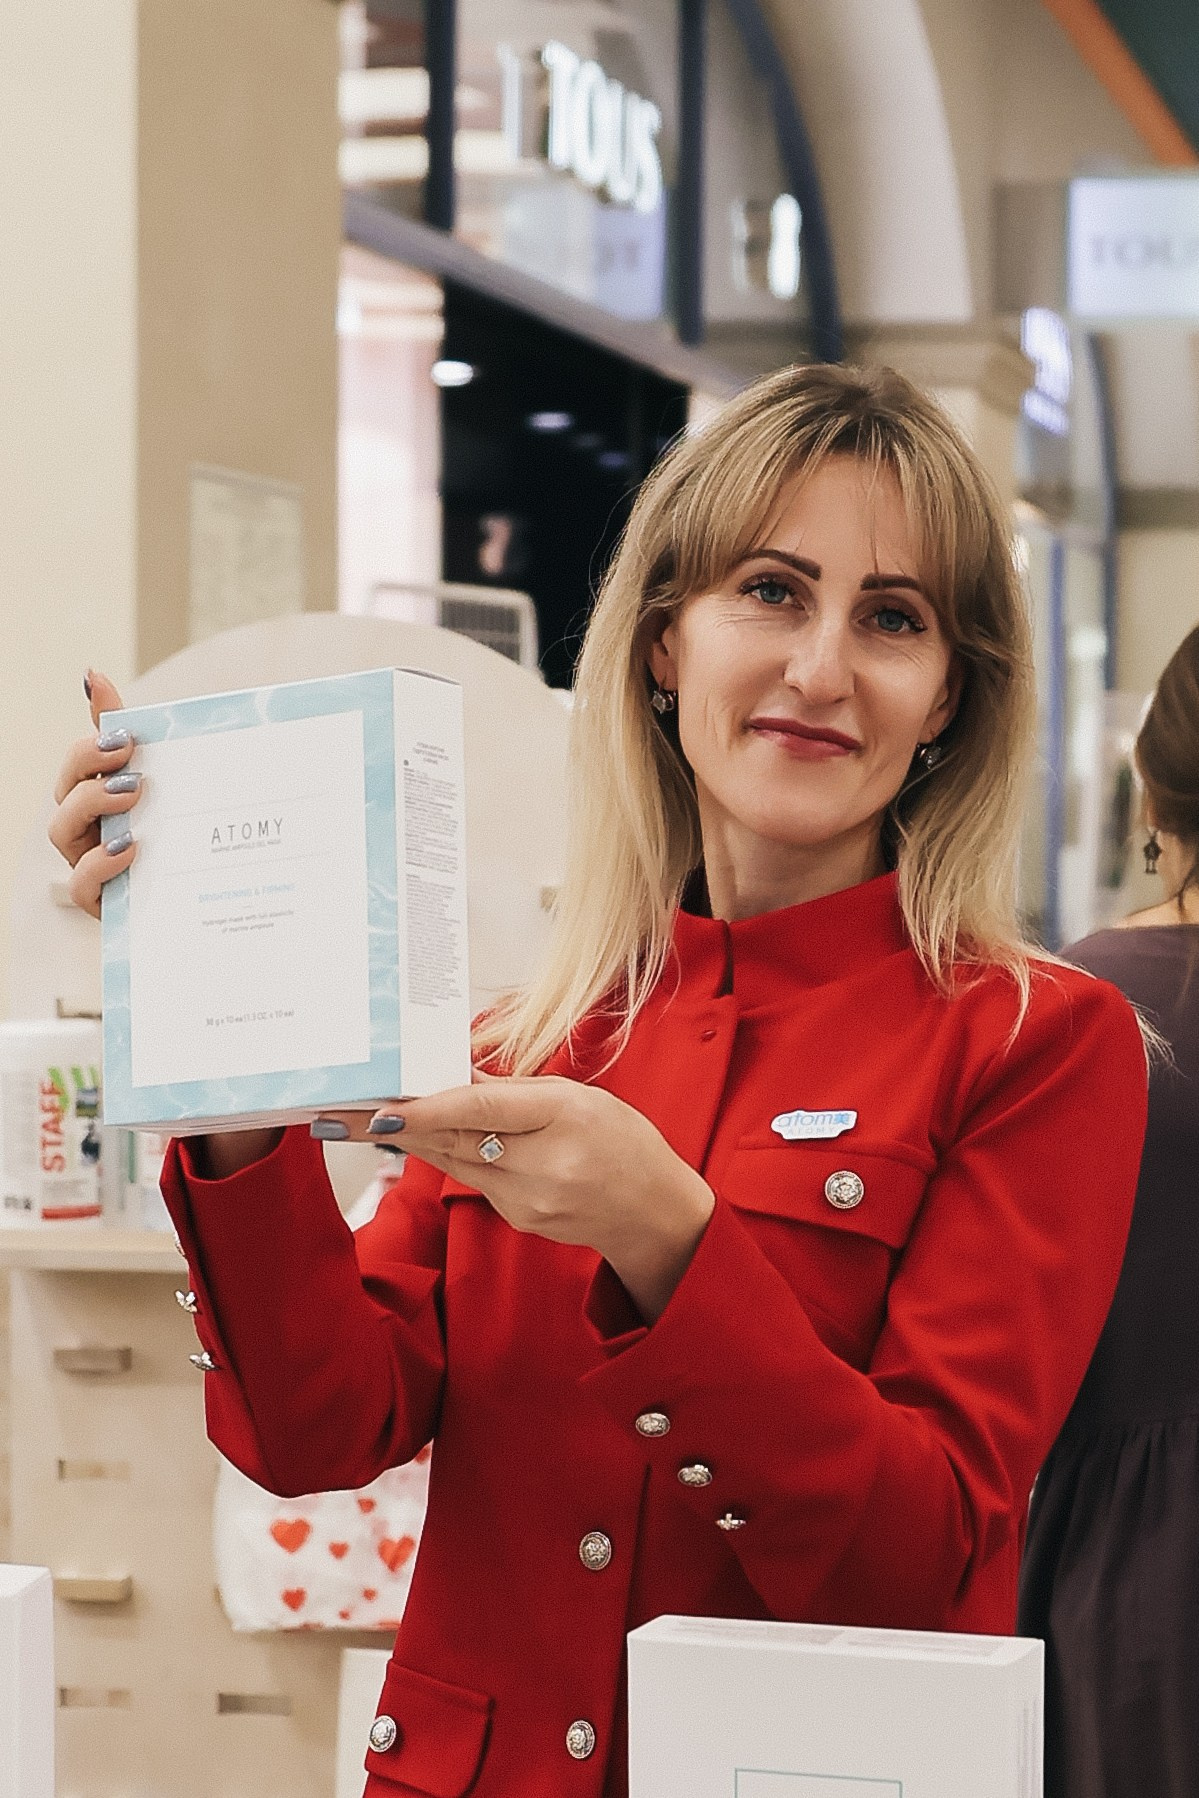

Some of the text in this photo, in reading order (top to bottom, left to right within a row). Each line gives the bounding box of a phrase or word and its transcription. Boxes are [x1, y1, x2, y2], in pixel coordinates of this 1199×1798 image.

[211, 817, 283, 844] ATOMY
[199, 887, 253, 902] BRIGHTENING
[40, 1080, 66, 1173] STAFF
